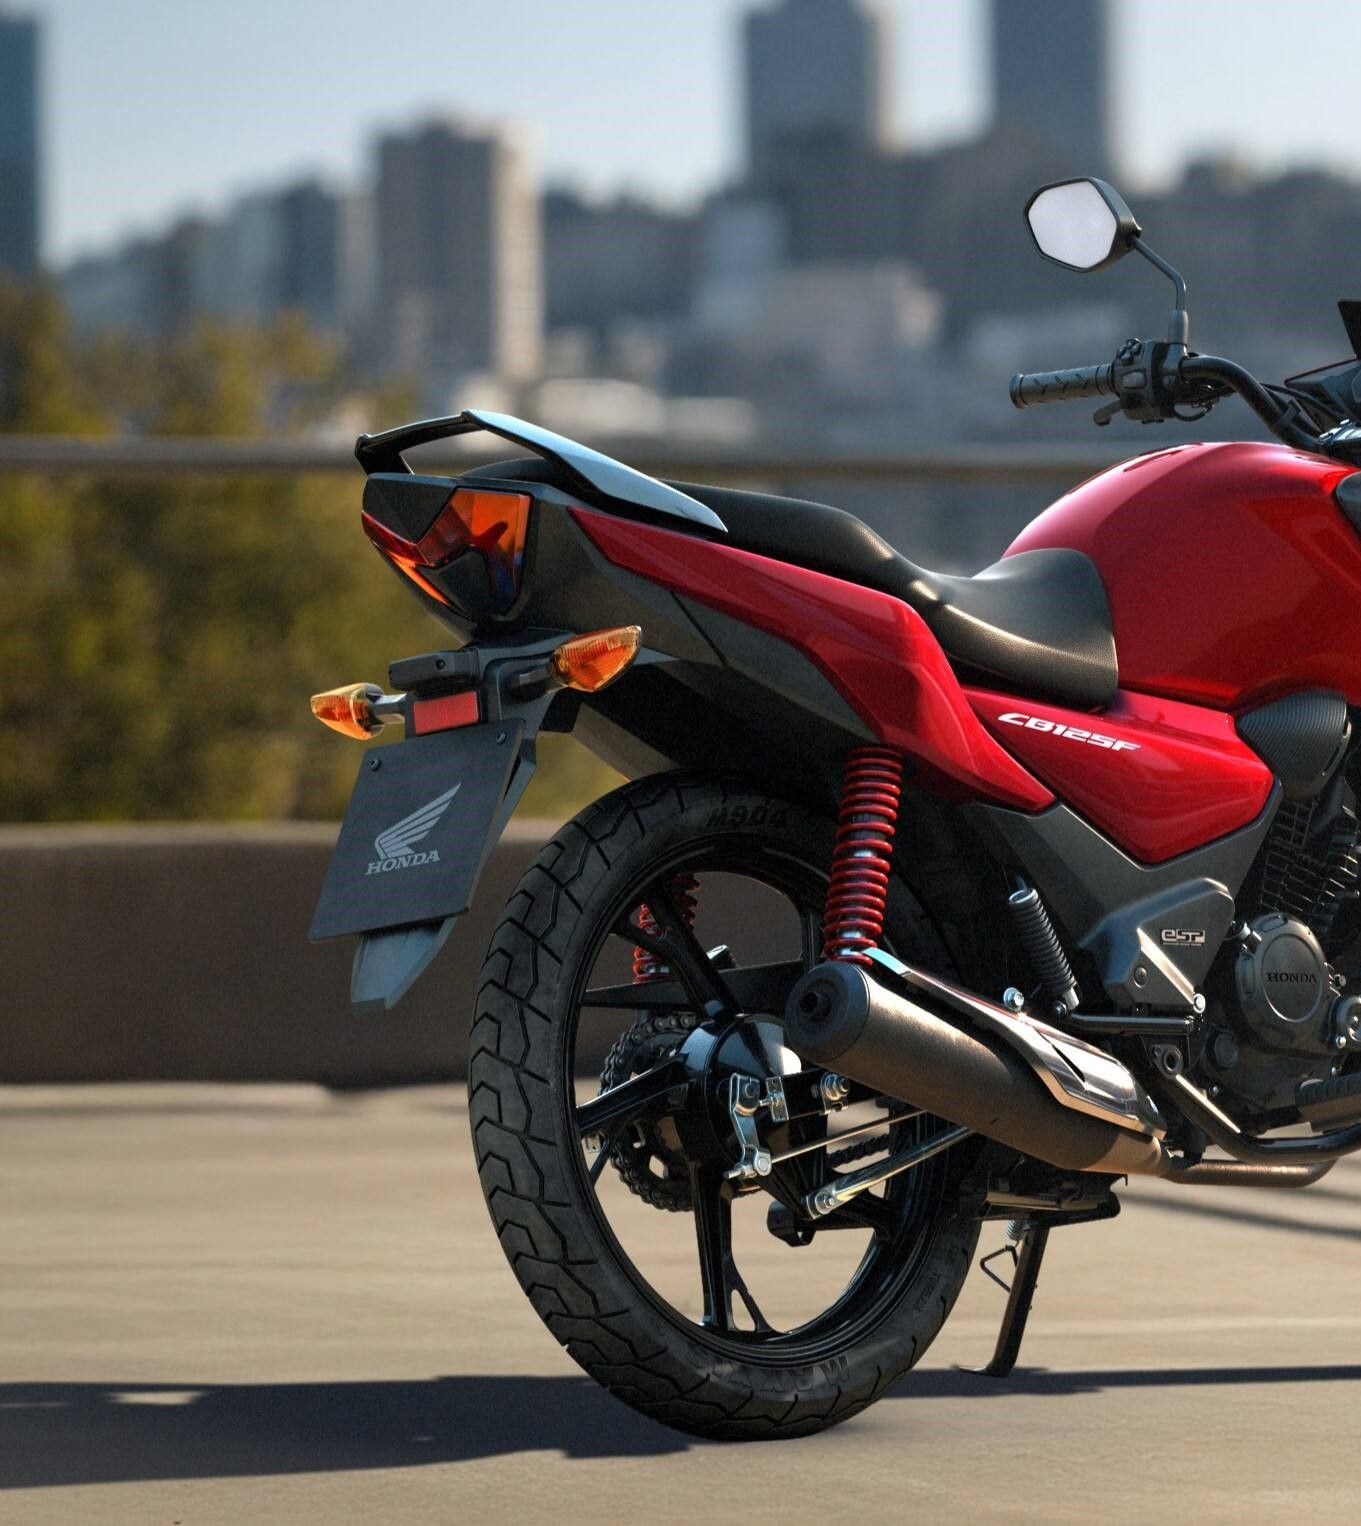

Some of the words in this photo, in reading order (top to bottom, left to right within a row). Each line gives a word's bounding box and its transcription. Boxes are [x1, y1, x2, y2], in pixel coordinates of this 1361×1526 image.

[998, 712, 1141, 751] CB125F
[365, 850, 441, 875] HONDA
[1265, 971, 1318, 984] HONDA
